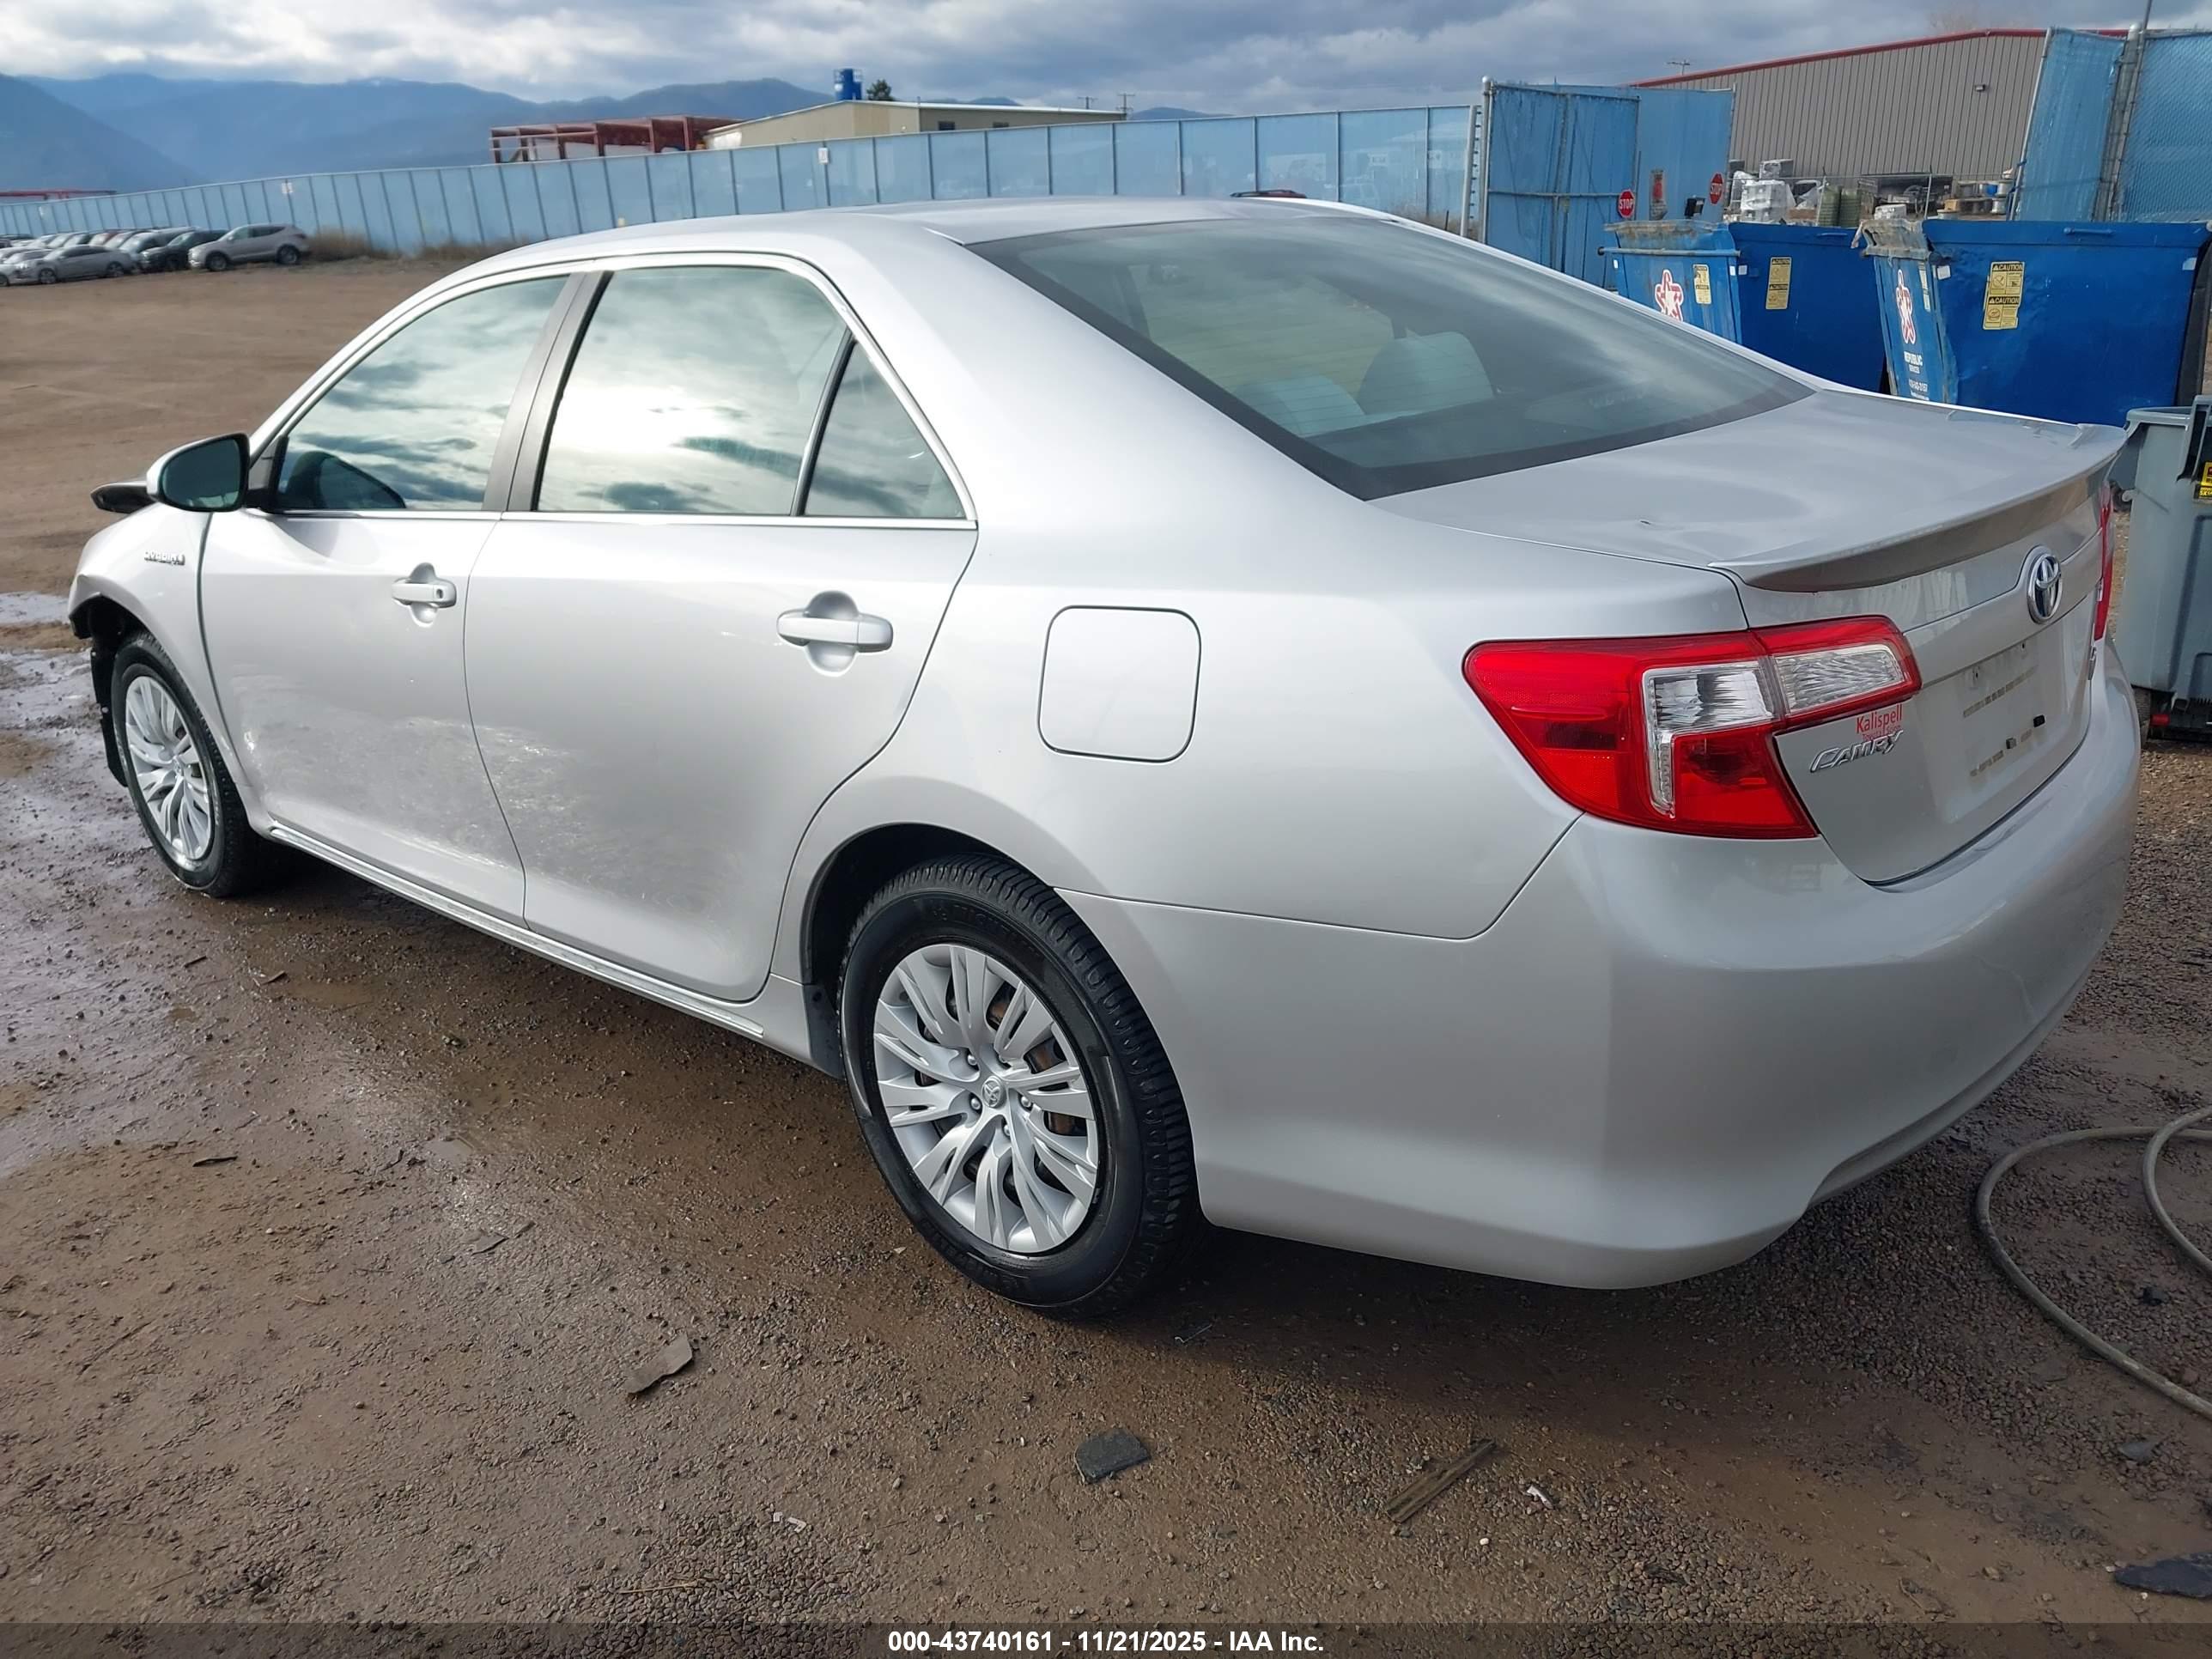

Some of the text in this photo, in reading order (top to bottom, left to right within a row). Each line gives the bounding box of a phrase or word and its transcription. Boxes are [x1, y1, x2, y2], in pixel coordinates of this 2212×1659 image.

[1620, 199, 1633, 209] STOP
[1856, 704, 1903, 733] Kalispell
[1810, 729, 1904, 773] CAMRY
